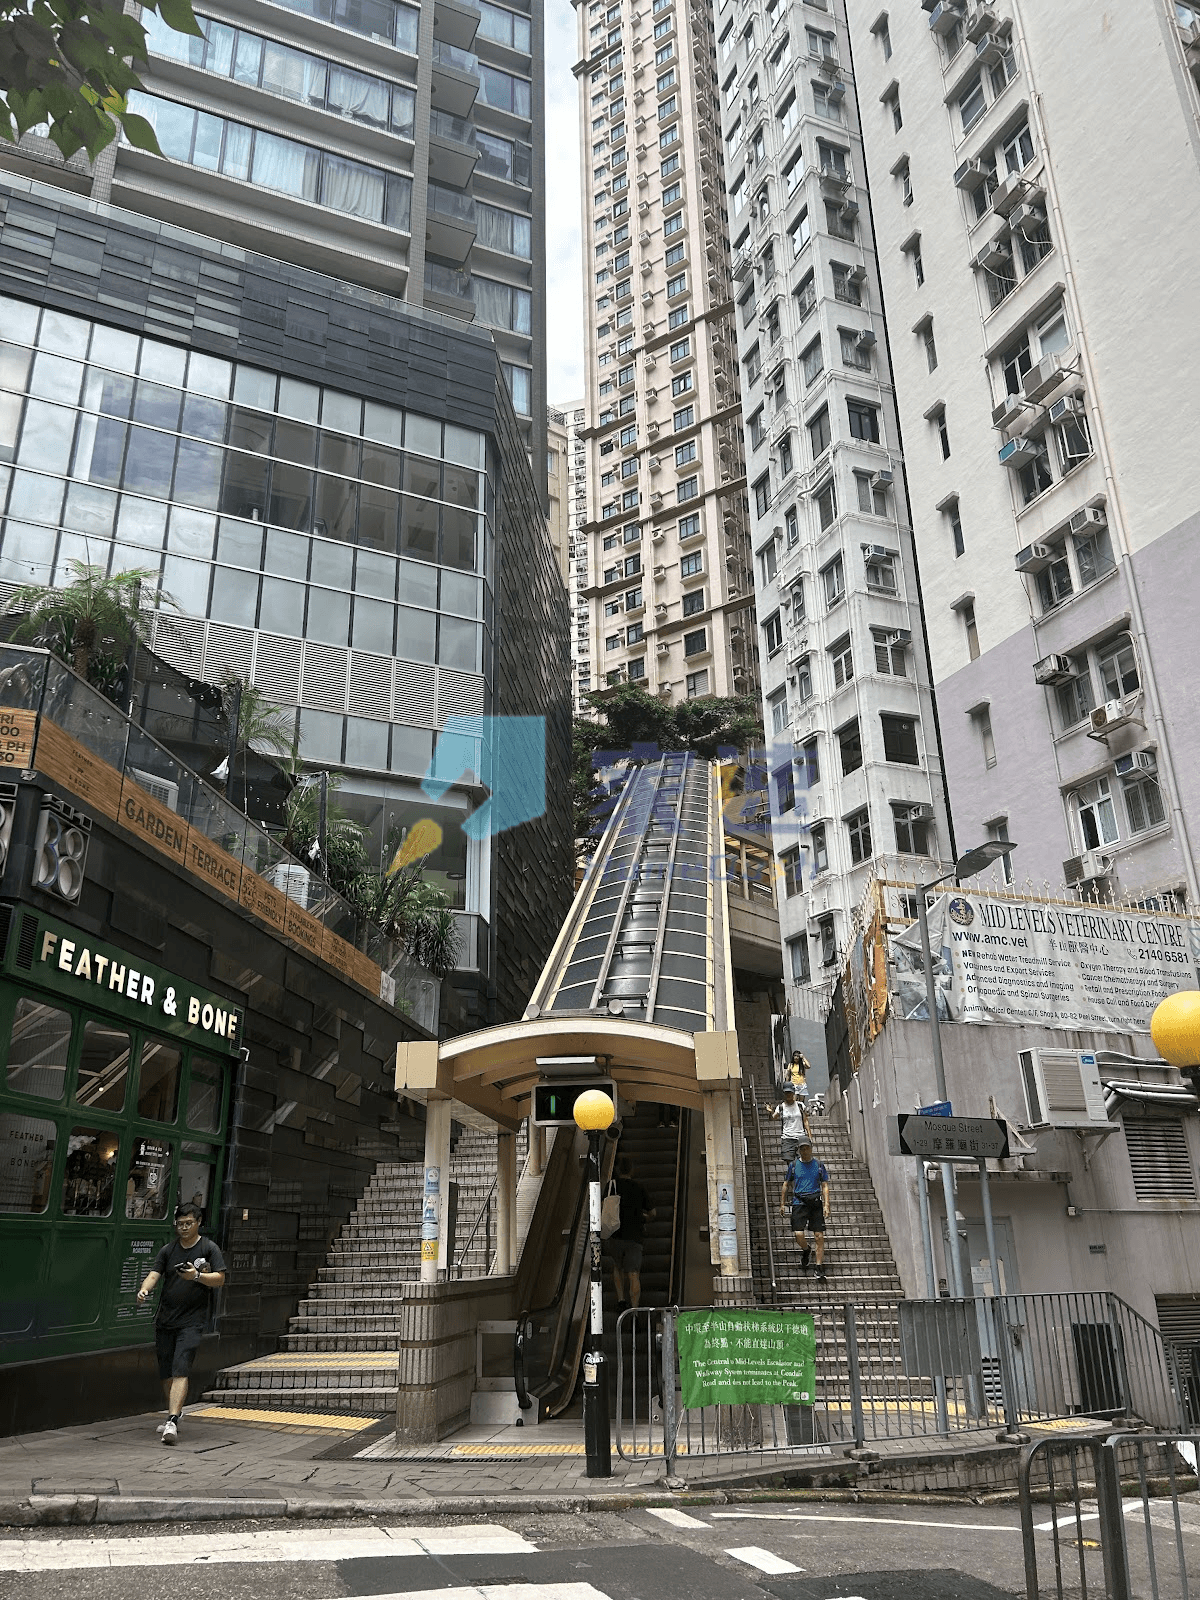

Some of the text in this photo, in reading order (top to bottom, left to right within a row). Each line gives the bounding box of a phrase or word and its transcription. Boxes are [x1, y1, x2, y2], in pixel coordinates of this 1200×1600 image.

[125, 798, 236, 891] GARDEN TERRACE
[257, 902, 283, 924] FRIENDLY
[978, 904, 1006, 928] MID
[1008, 906, 1056, 934] LEVELS
[1056, 912, 1135, 942] VETERINARY
[1136, 920, 1186, 948] CENTRE
[288, 920, 316, 948] BOOKINGS
[952, 932, 1028, 948] www.amc.vet
[976, 951, 998, 961] Rehab
[998, 954, 1018, 962] Water
[1018, 956, 1048, 965] Treadmill
[1048, 958, 1072, 968] Service
[1138, 948, 1189, 964] 2140 6581
[993, 964, 1005, 973] and
[1006, 966, 1028, 976] Export
[1028, 968, 1056, 978] Services
[1080, 962, 1192, 979] Oxygen Therapy and Blood Transfusions
[40, 930, 238, 1041] FEATHER & BONE
[998, 976, 1036, 987] Diagnostics
[1036, 979, 1048, 988] and
[1050, 980, 1074, 992] Imaging
[1082, 973, 1180, 990] Cancer Chemotherapy and Surgery
[1007, 988, 1020, 998] and
[1020, 990, 1040, 1000] Spinal
[1040, 992, 1070, 1002] Surgeries
[1103, 985, 1114, 994] and
[1114, 986, 1152, 997] Prescription
[1106, 998, 1118, 1006] Call
[1118, 998, 1130, 1007] and
[1130, 999, 1145, 1008] Food
[1040, 1010, 1054, 1020] Shop
[1120, 1016, 1132, 1024] right
[1132, 1016, 1146, 1025] here
[924, 1120, 983, 1133] Mosque Street
[10, 1130, 44, 1143] FEATHER
[933, 1138, 978, 1152] 摩羅廟街
[10, 1158, 35, 1168] BONE
[693, 1360, 706, 1368] The
[707, 1358, 730, 1366] Central
[735, 1358, 766, 1366] Mid-Levels
[766, 1359, 792, 1367] Escalator
[794, 1360, 804, 1368] and
[695, 1369, 722, 1378] Walkway
[744, 1368, 772, 1376] terminates
[702, 1379, 716, 1388] Road
[718, 1378, 731, 1386] and
[752, 1378, 764, 1386] lead
